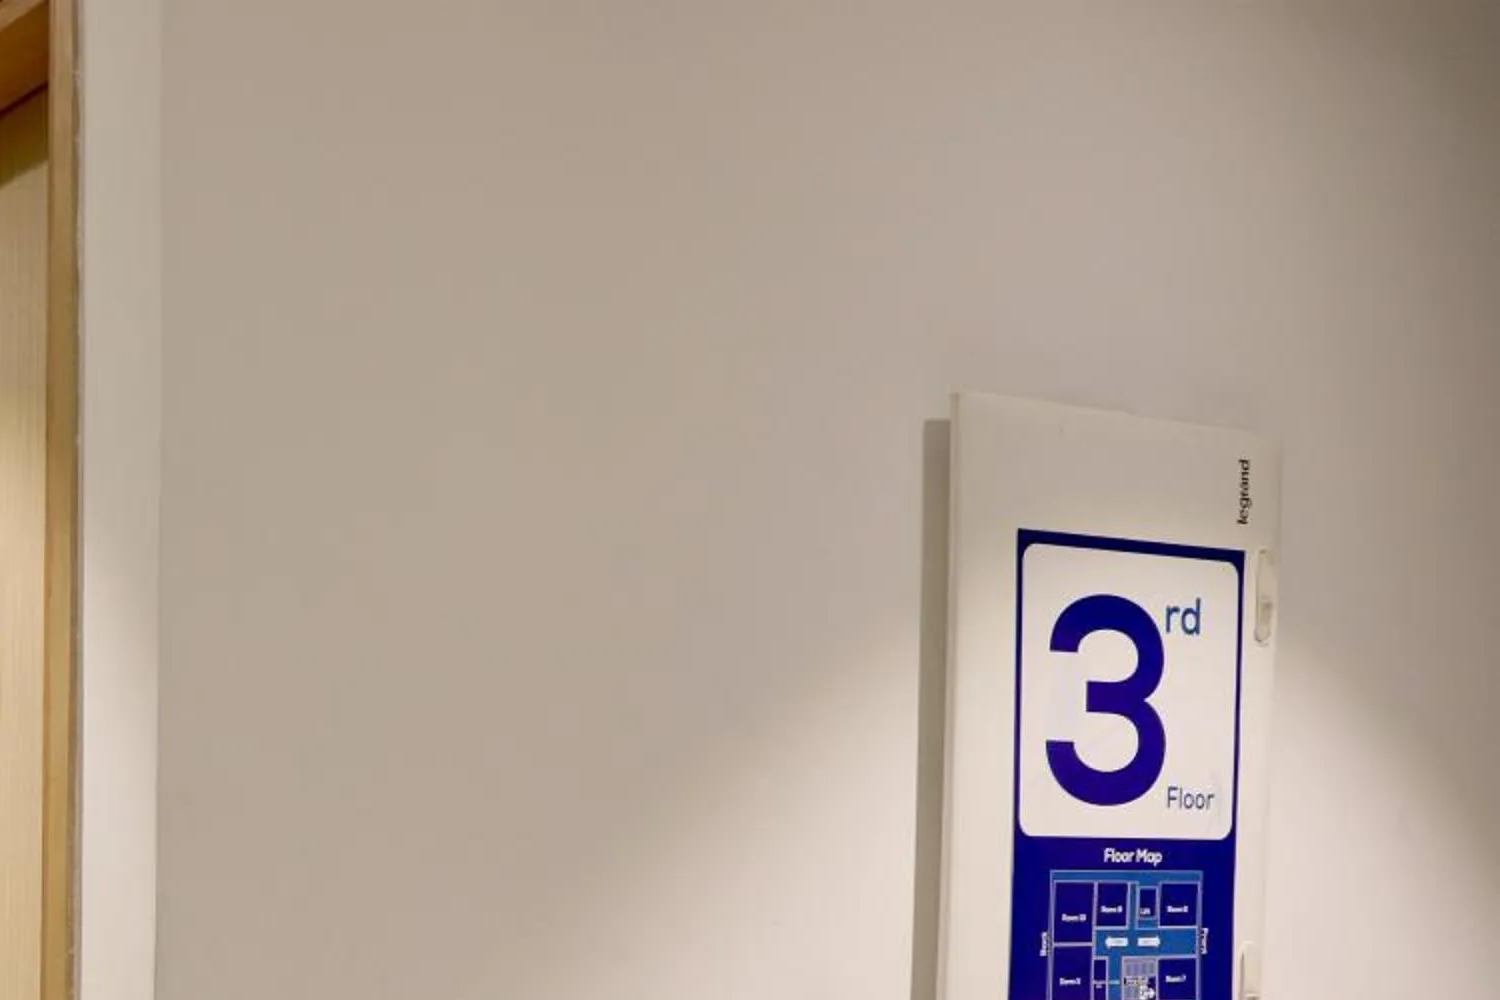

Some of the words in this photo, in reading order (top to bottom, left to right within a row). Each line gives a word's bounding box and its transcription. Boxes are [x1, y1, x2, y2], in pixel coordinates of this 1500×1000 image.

[1166, 786, 1215, 810] Floor
[1103, 847, 1135, 863] Floor
[1135, 847, 1163, 867] Map
